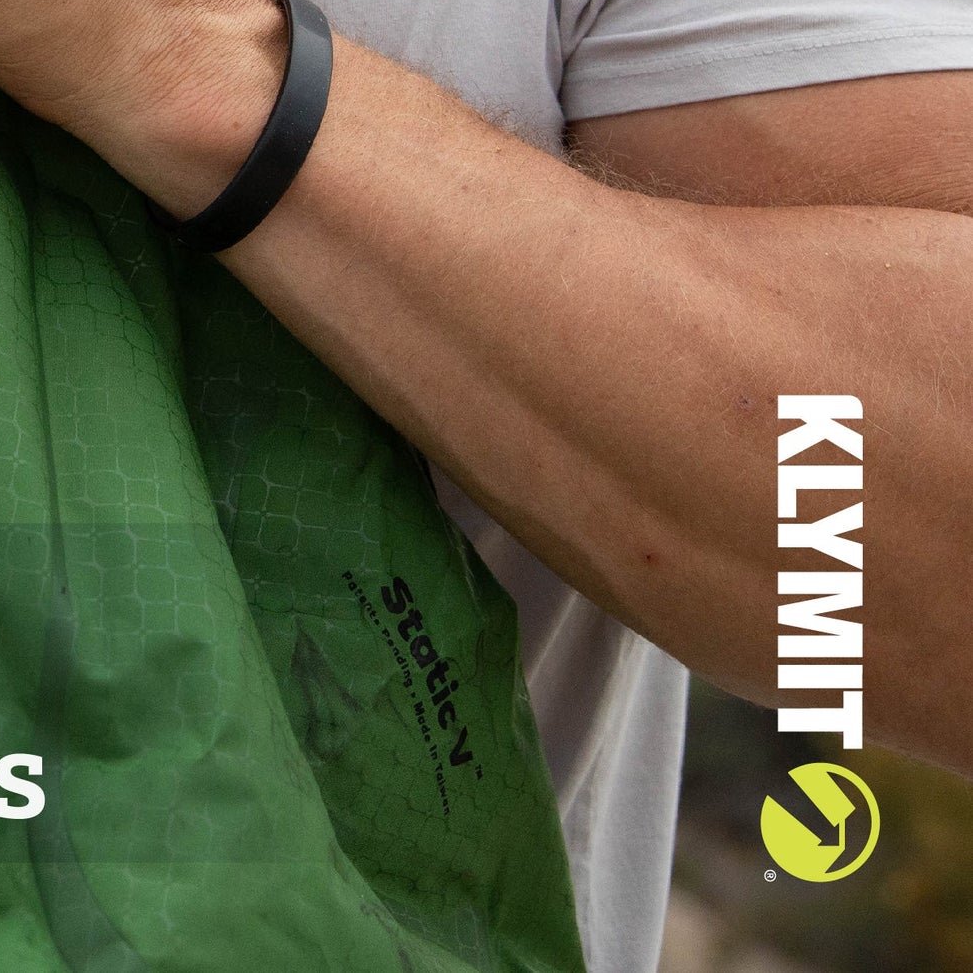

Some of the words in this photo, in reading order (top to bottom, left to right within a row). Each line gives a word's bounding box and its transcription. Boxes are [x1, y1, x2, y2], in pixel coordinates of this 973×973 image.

[381, 576, 459, 731] Static
[449, 726, 474, 767] V
[381, 627, 414, 689] Pending
[413, 700, 431, 743] Made
[435, 763, 451, 817] Taiwan
